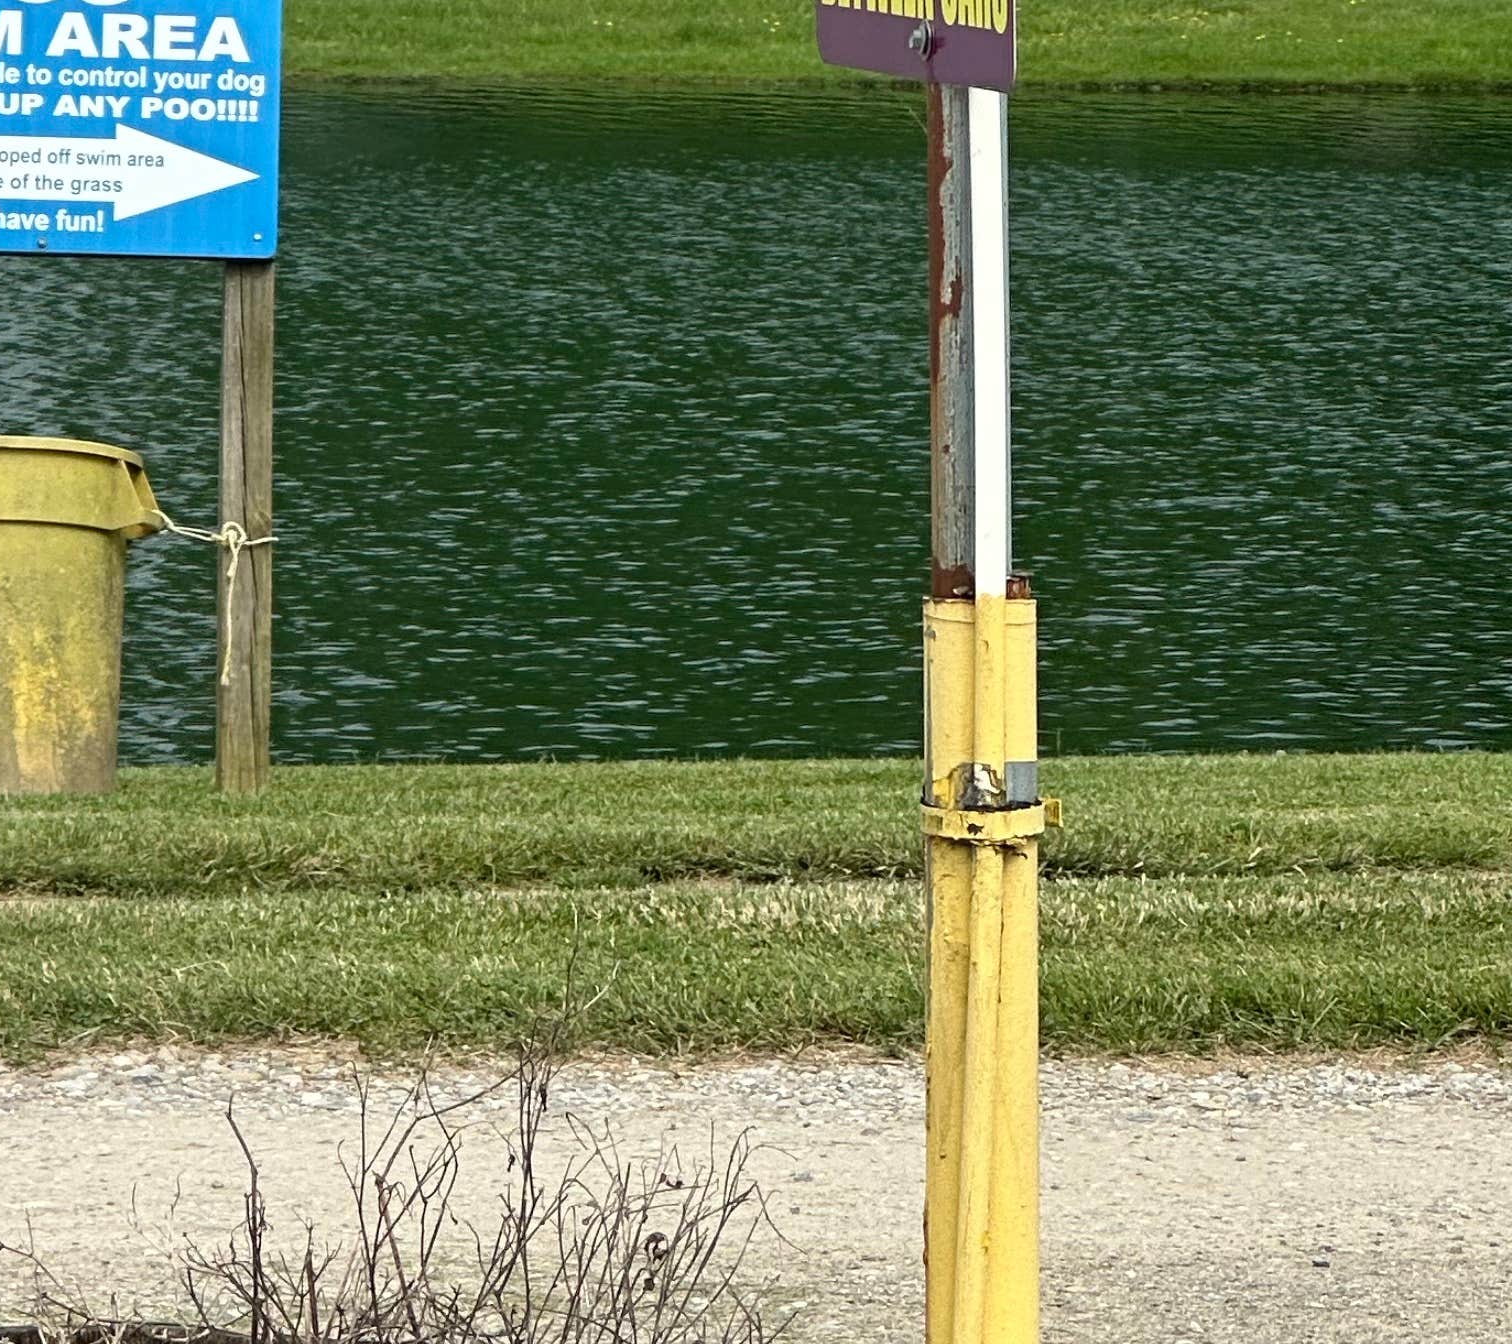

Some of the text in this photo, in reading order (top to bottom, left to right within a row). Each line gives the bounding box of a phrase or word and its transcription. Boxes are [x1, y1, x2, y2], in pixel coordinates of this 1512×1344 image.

[45, 11, 251, 63] AREA
[26, 64, 52, 85] to
[58, 66, 147, 88] control
[153, 71, 212, 94] your
[217, 68, 265, 97] dog
[53, 94, 131, 118] ANY
[141, 97, 259, 122] POO!!!!
[47, 148, 71, 165] off
[76, 150, 121, 166] swim
[127, 153, 165, 167] area
[10, 173, 29, 190] of
[35, 174, 64, 191] the
[70, 178, 124, 195] grass
[55, 208, 105, 233] fun!
